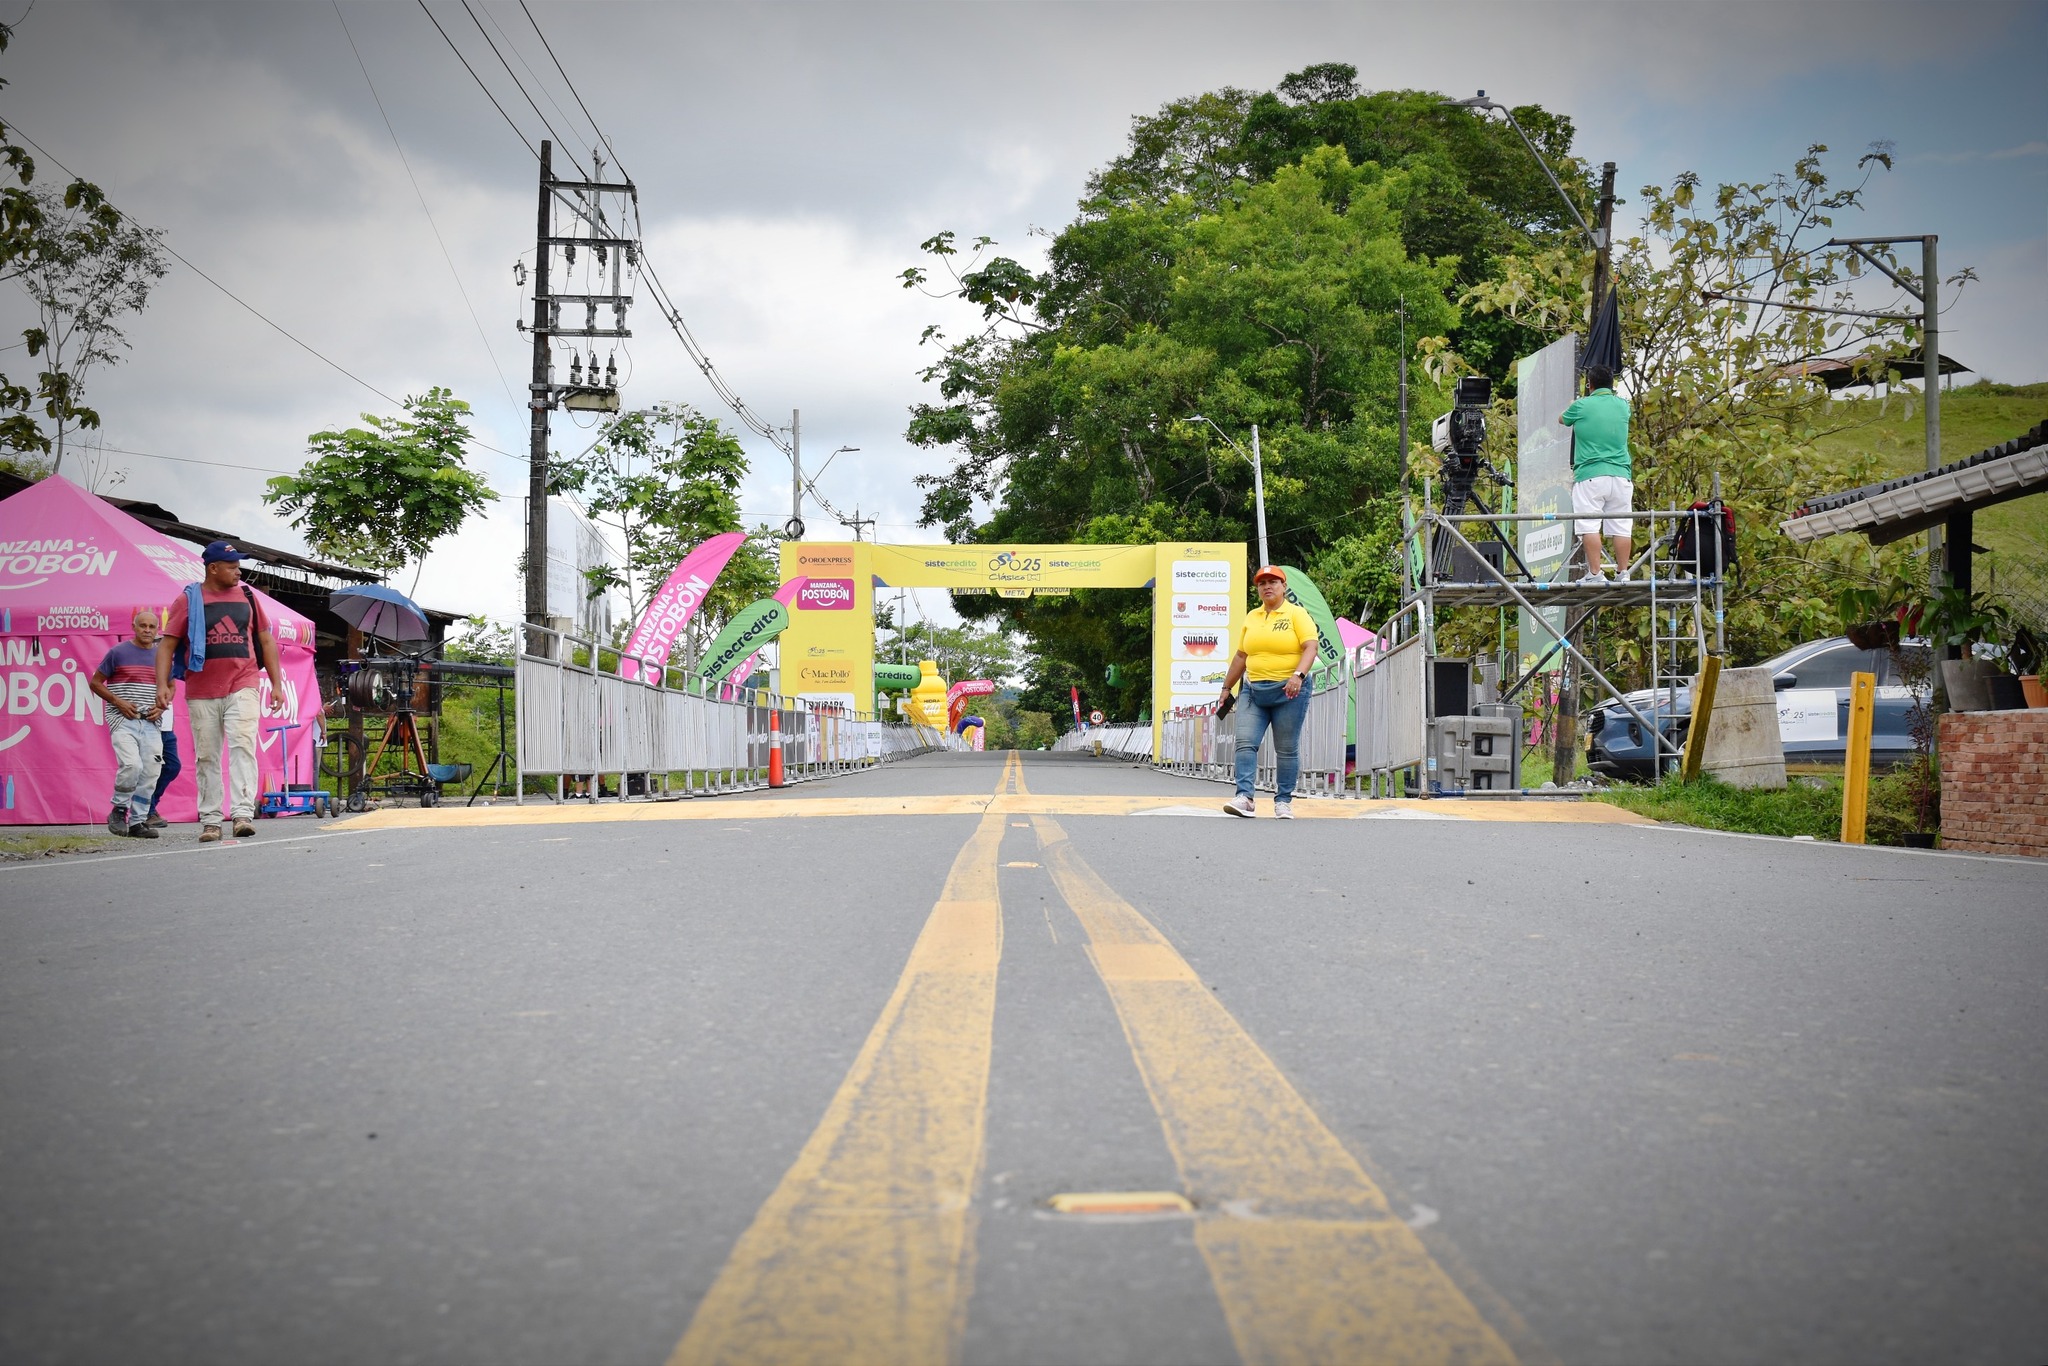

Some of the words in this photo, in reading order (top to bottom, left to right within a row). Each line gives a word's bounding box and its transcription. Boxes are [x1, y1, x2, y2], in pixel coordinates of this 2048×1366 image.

[1021, 558, 1041, 571] 25
[989, 573, 1025, 581] Clásico
[50, 606, 91, 614] MANZANA
[1197, 604, 1227, 612] Pereira
[630, 593, 673, 658] MANZANA
[1182, 635, 1219, 646] SUNDARK
[811, 669, 829, 678] Mac
[831, 669, 849, 678] Pollo
[1793, 711, 1804, 719] 25
